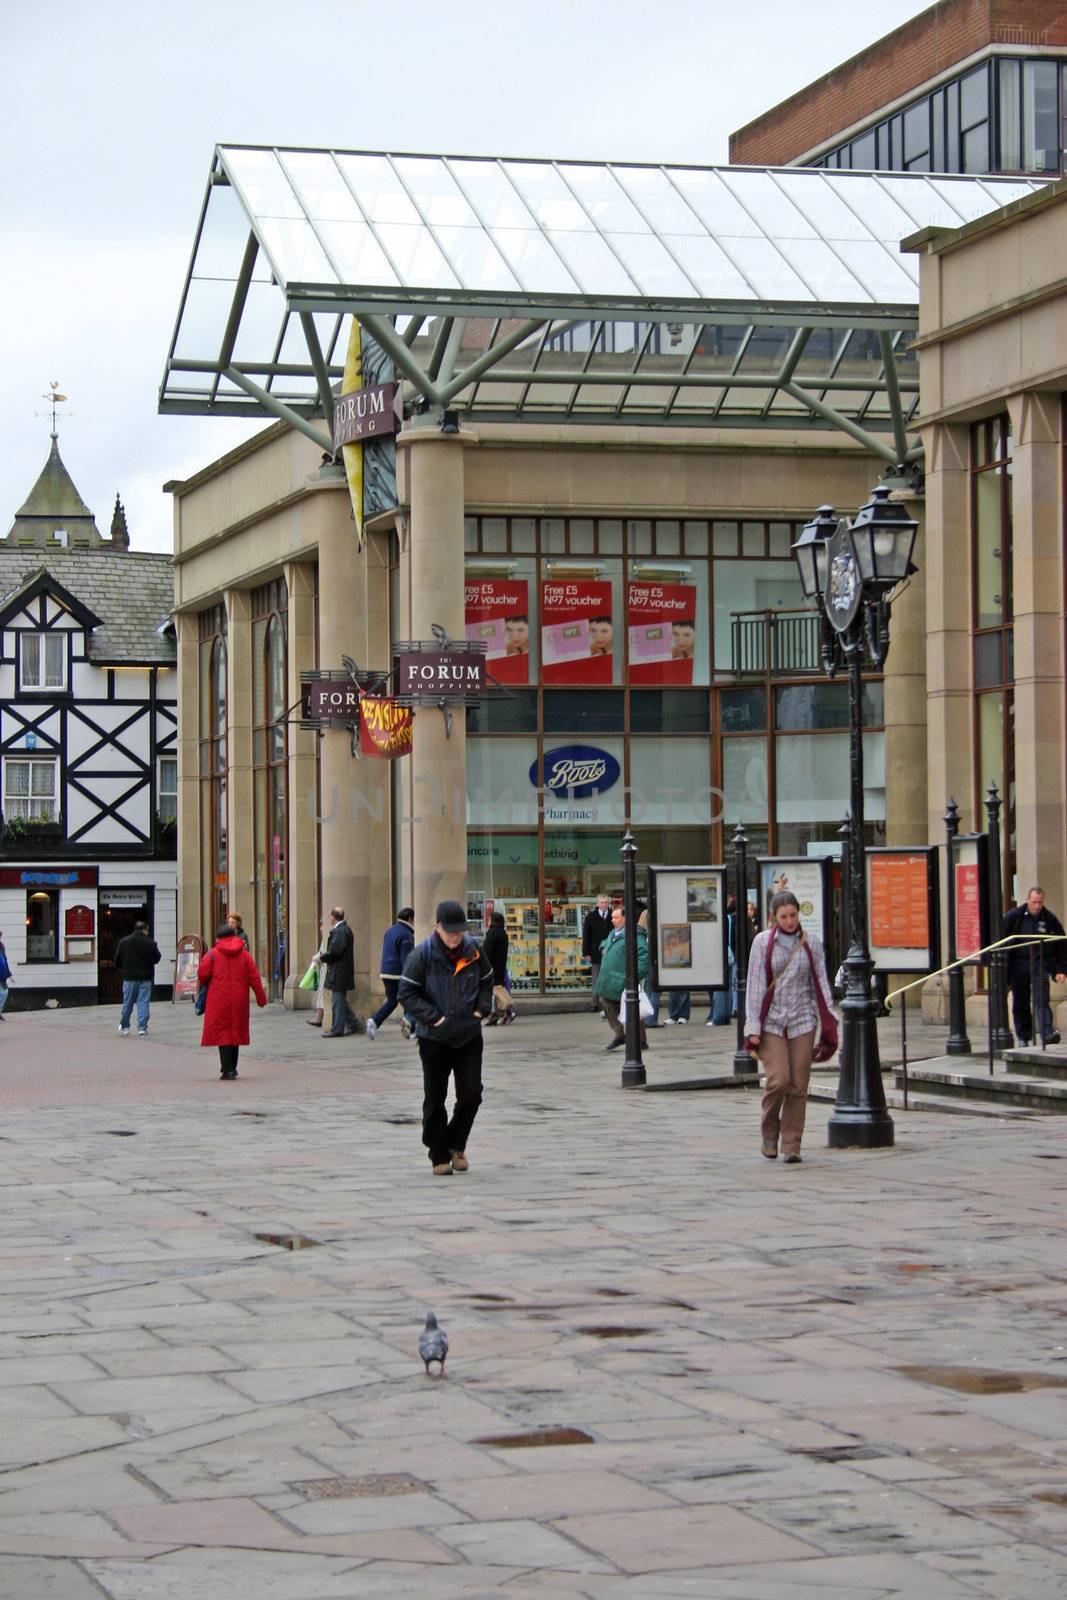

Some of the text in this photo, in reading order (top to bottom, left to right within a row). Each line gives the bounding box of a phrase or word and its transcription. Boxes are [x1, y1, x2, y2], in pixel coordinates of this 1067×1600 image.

[336, 390, 385, 426] FORUM
[544, 585, 578, 595] Free £5
[629, 586, 664, 598] Free £5
[480, 595, 519, 605] voucher
[565, 596, 602, 606] voucher
[649, 599, 687, 609] voucher
[408, 665, 480, 680] FORUM
[319, 692, 361, 705] FOR
[549, 759, 606, 788] Boots
[543, 808, 599, 820] Pharmacy
[544, 849, 578, 860] athing
